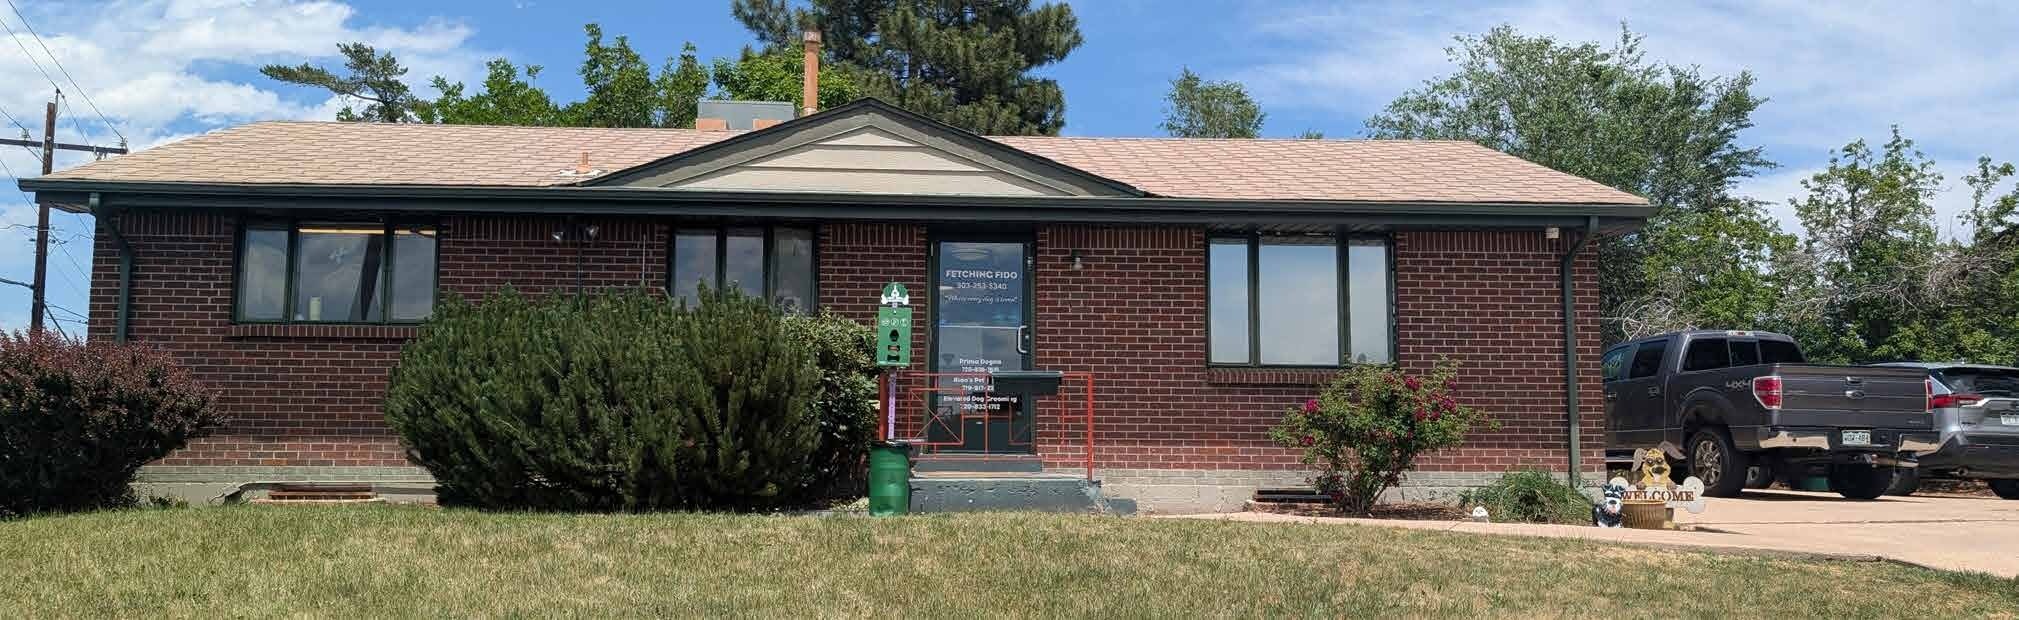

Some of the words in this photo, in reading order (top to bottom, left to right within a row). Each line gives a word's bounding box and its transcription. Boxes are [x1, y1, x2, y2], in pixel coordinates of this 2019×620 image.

[945, 270, 994, 279] FETCHING
[995, 271, 1018, 279] FIDO
[959, 358, 980, 366] Prima
[971, 395, 985, 403] Dog
[1621, 490, 1694, 502] WELCOME
